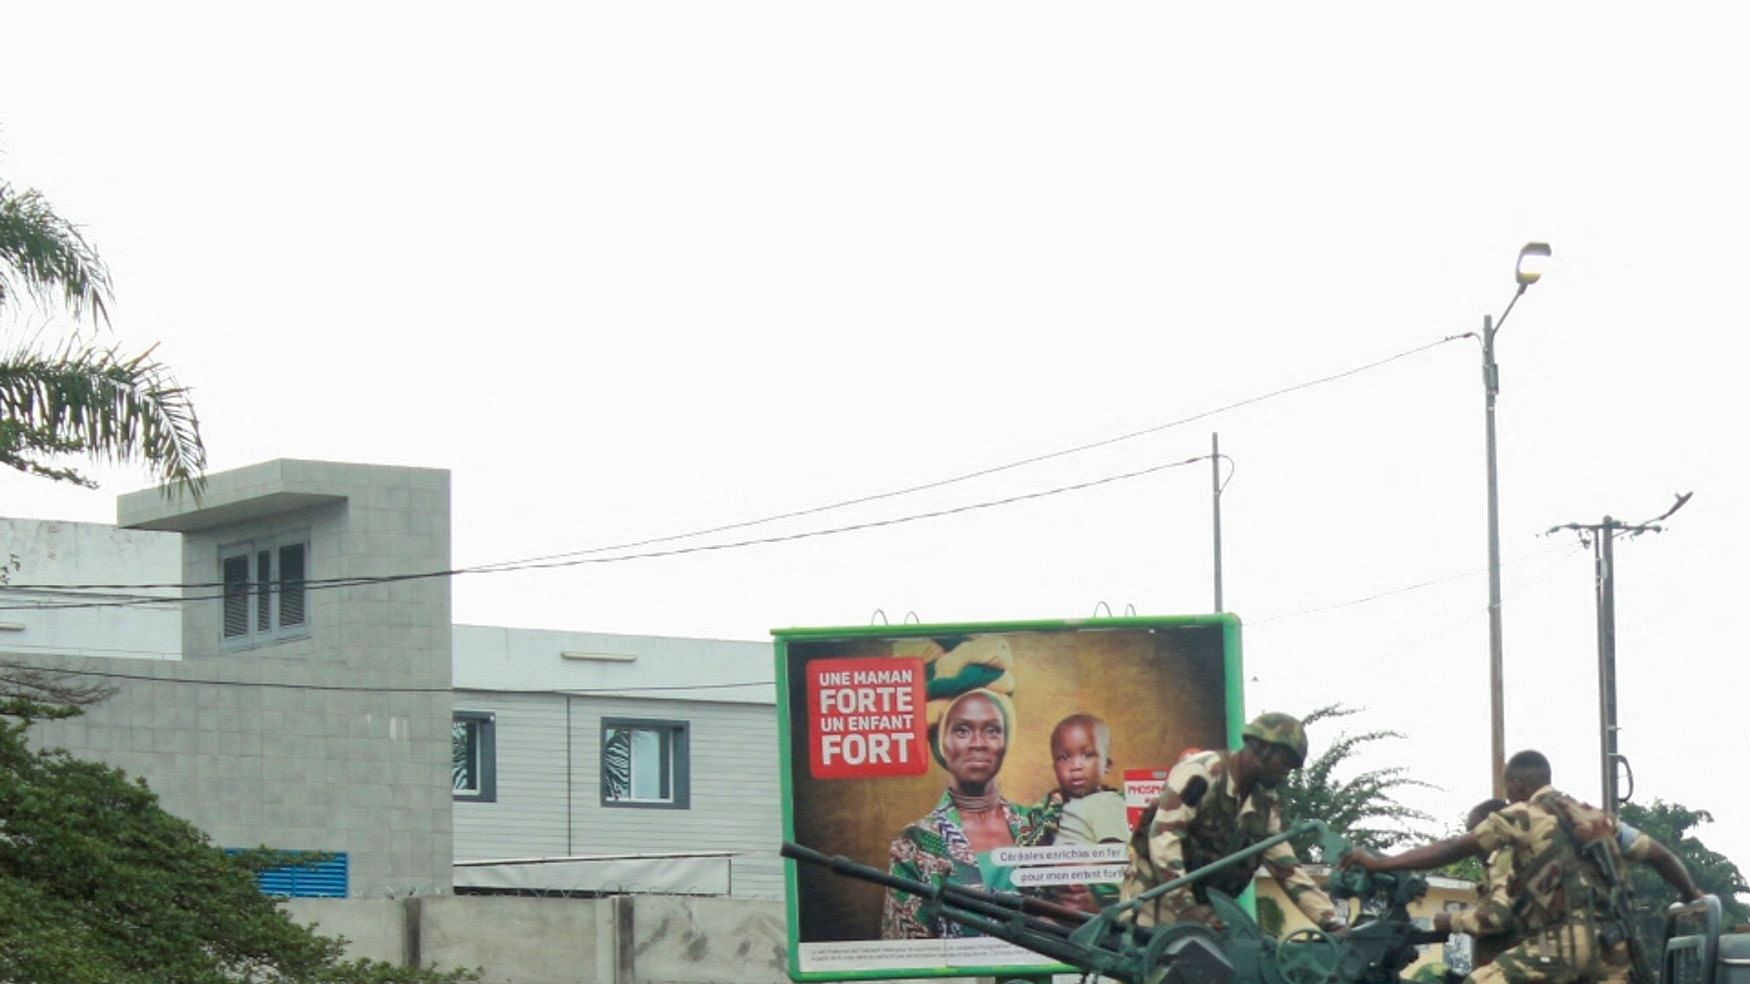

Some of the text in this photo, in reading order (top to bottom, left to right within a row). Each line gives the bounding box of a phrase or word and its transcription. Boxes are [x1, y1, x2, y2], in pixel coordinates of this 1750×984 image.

[819, 669, 913, 687] UNE MAMAN
[820, 687, 913, 714] FORTE
[820, 714, 914, 733] UN ENFANT
[821, 732, 914, 765] FORT
[1021, 873, 1044, 883] pour
[1046, 872, 1070, 881] mon
